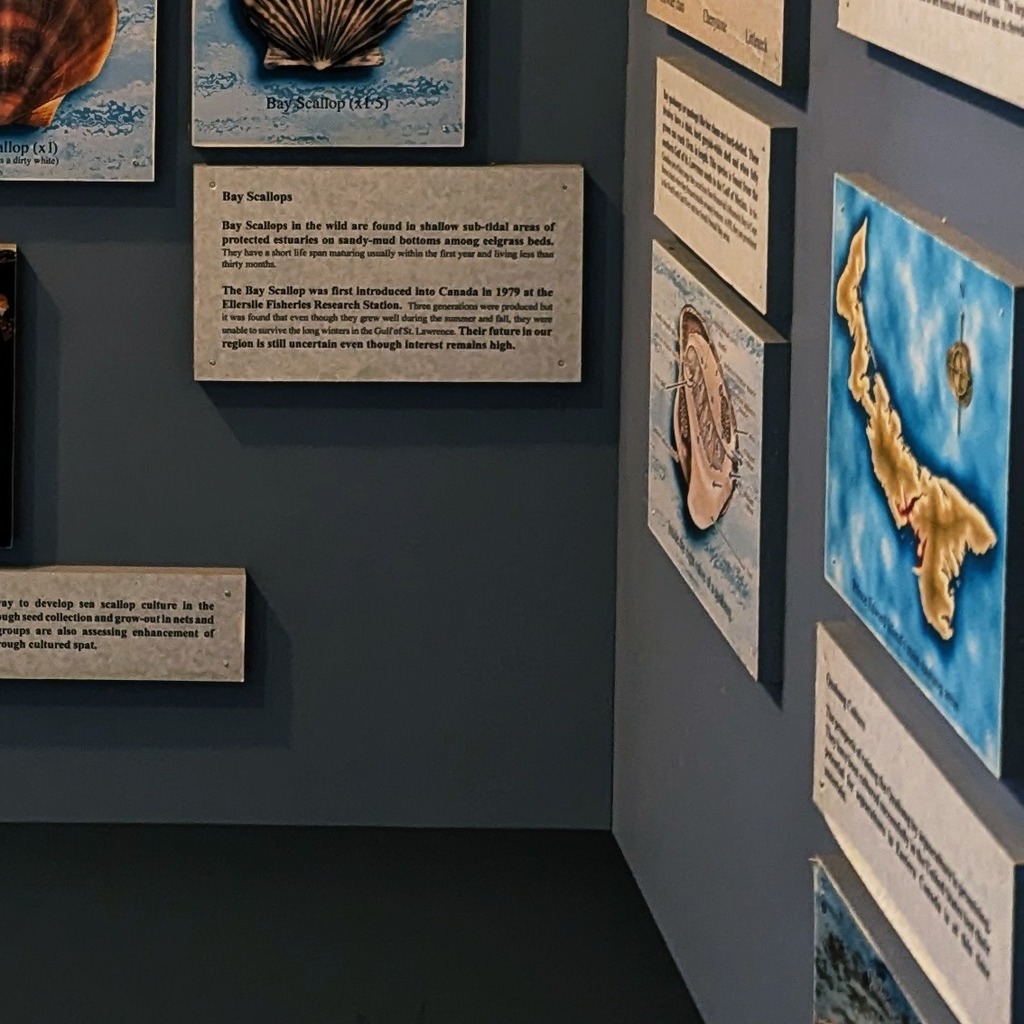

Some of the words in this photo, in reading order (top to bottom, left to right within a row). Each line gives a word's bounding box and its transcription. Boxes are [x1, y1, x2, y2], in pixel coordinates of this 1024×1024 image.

[266, 96, 291, 112] Bay
[296, 96, 346, 112] Scallop
[12, 156, 31, 166] dirty
[33, 156, 59, 165] white)
[222, 192, 244, 203] Bay
[246, 192, 292, 203] Scallops
[223, 285, 242, 295] The
[245, 285, 265, 297] Bay
[268, 286, 306, 297] Scallop
[308, 287, 328, 295] was
[331, 286, 353, 295] first
[356, 286, 411, 296] introduced
[415, 286, 435, 296] into
[438, 287, 478, 296] Canada
[481, 287, 492, 296] in
[496, 287, 520, 296] 1979
[523, 287, 534, 296] at
[536, 287, 553, 296] the
[28, 639, 71, 649] cultured
[73, 640, 97, 652] spat.
